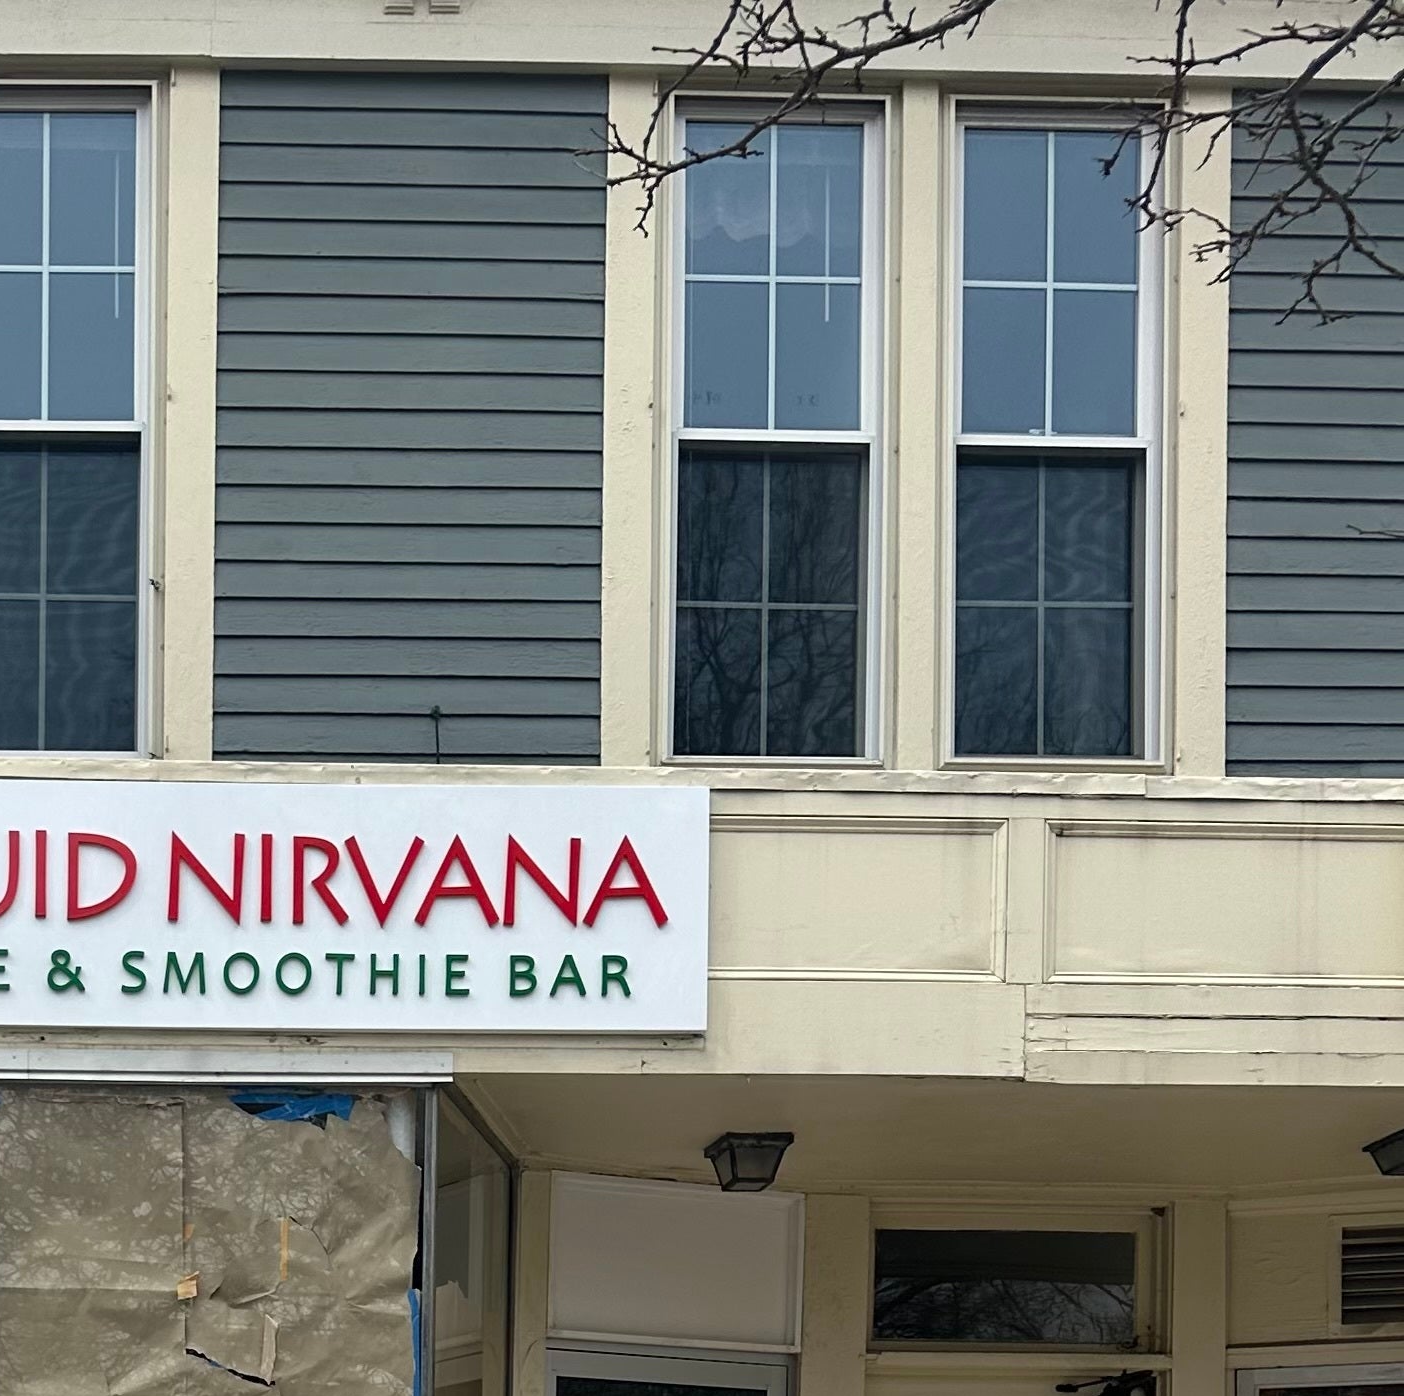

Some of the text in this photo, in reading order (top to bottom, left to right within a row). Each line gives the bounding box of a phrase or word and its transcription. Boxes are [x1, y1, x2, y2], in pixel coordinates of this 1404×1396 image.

[167, 830, 668, 928] NIRVANA
[47, 949, 85, 993] &
[120, 950, 471, 996] SMOOTHIE
[509, 954, 631, 997] BAR
